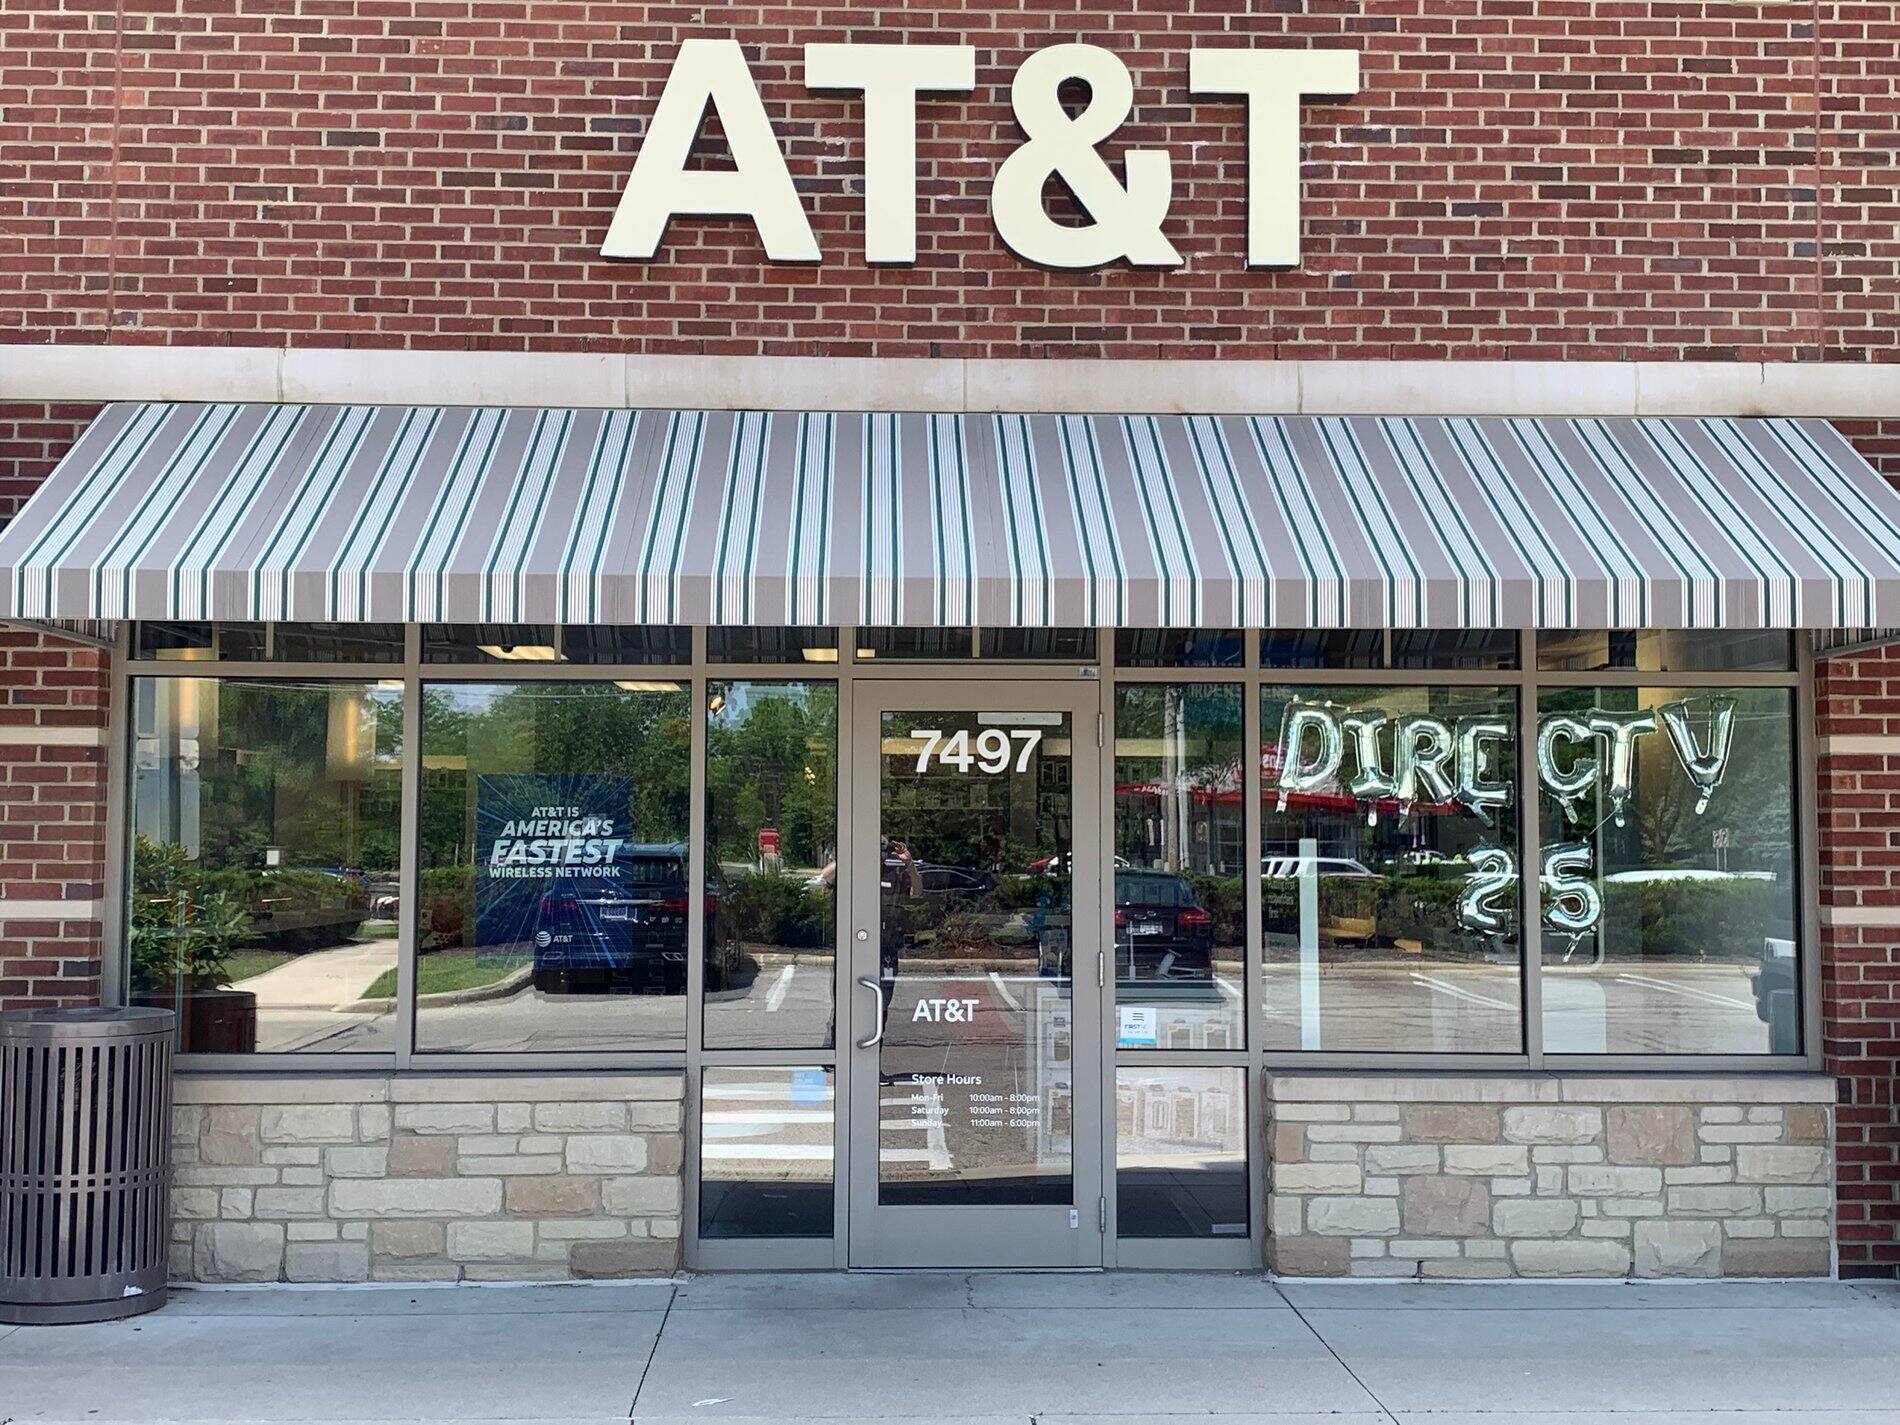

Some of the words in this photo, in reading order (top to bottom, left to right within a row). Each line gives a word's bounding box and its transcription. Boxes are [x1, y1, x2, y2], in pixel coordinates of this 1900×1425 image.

[600, 38, 1360, 268] AT&T
[910, 729, 1042, 774] 7497
[1279, 695, 1737, 810] DIRECTV
[531, 806, 564, 818] AT&T
[567, 806, 580, 818] IS
[500, 819, 614, 837] AMERICA'S
[490, 838, 624, 865] FASTEST
[489, 866, 552, 878] WIRELESS
[555, 866, 621, 878] NETWORK
[1456, 837, 1605, 936] 25
[553, 934, 573, 943] AT&T
[911, 998, 980, 1022] AT&T
[911, 1074, 944, 1085] Store
[947, 1074, 982, 1085] Hours
[911, 1093, 944, 1101] Mon-Fri
[1009, 1094, 1040, 1103] 8:00pm
[911, 1106, 949, 1116] Saturday
[1009, 1107, 1040, 1116] 8:00pm
[911, 1119, 942, 1129] Sunday
[1009, 1120, 1040, 1129] 6:00pm
